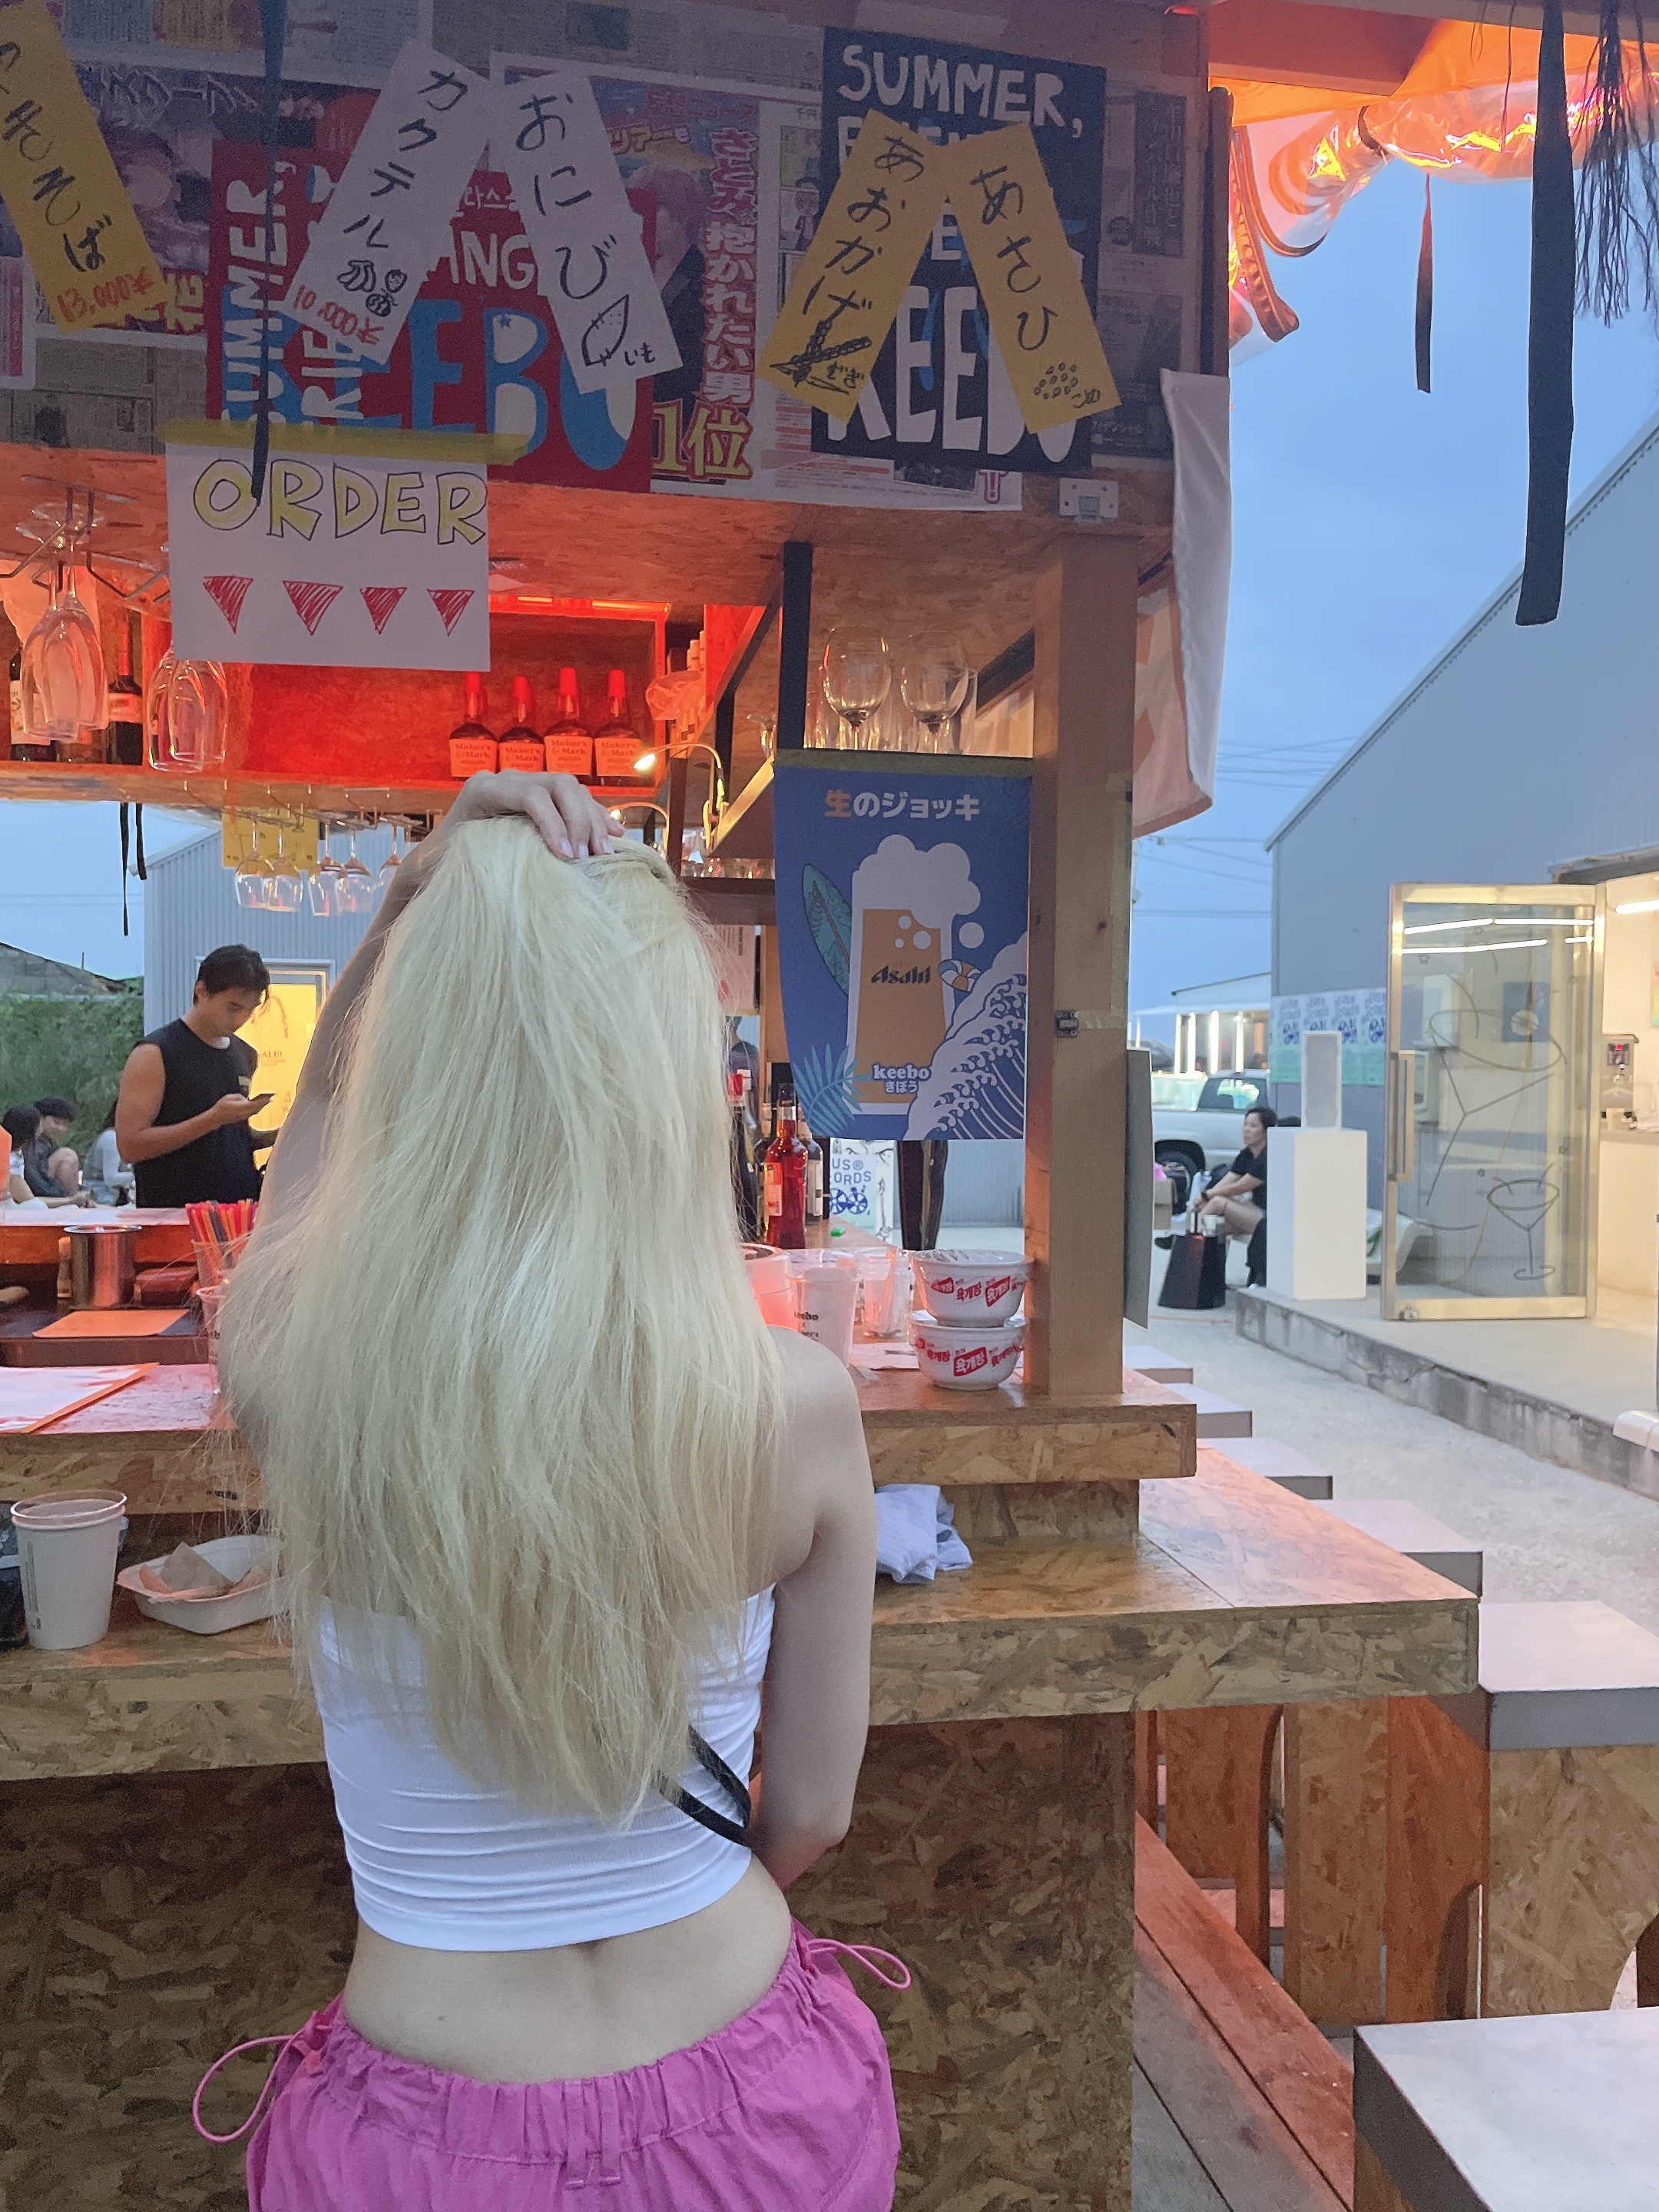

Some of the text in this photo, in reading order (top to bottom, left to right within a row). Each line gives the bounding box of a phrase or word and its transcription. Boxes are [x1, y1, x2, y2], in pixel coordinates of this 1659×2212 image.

[837, 43, 1083, 139] SUMMER,
[971, 165, 1058, 351] あさひ
[701, 220, 757, 403] 抱かれたい男
[654, 401, 753, 481] 1位
[193, 459, 488, 545] ORDER
[824, 789, 982, 821] 生のジョッキ
[870, 965, 932, 985] Asahi
[873, 1064, 931, 1081] keebo
[884, 1080, 919, 1094] きぼう
[955, 1350, 987, 1375] 육개장
